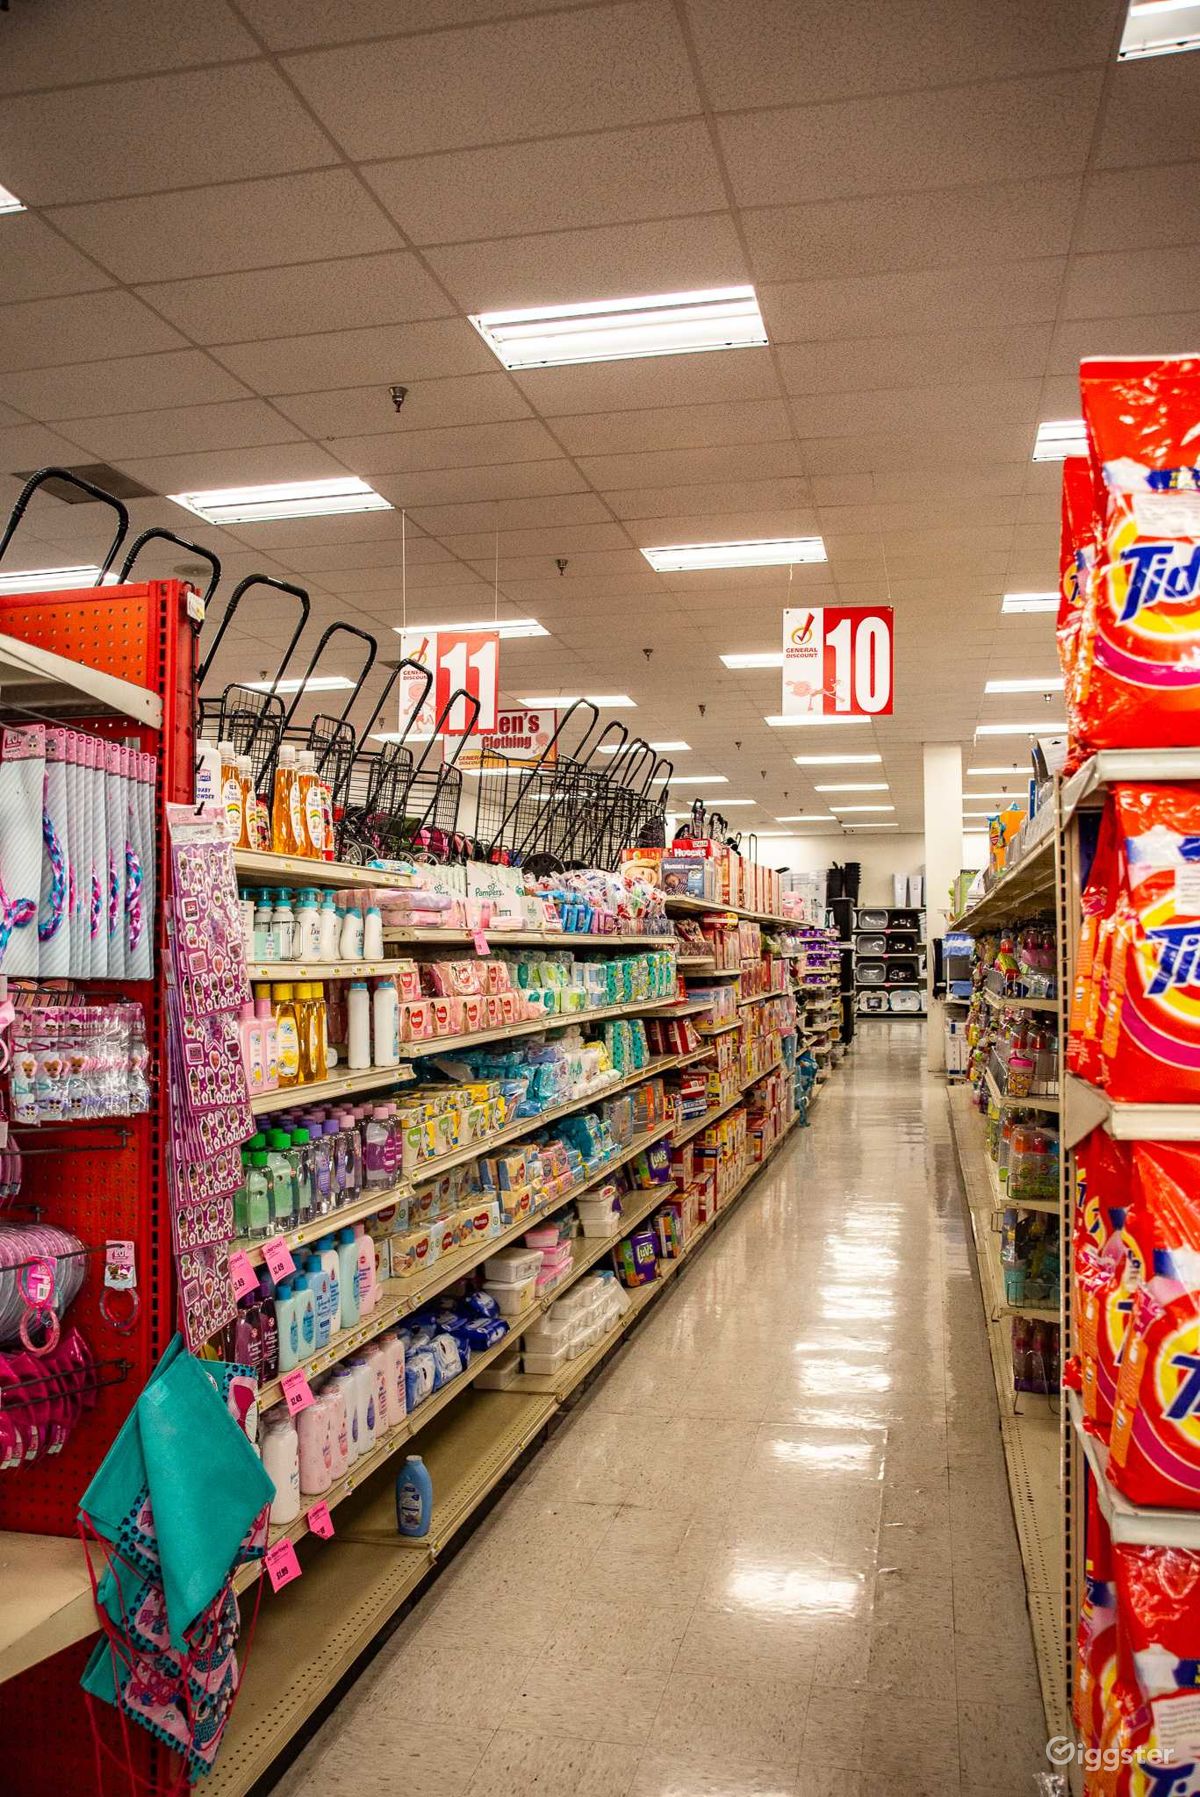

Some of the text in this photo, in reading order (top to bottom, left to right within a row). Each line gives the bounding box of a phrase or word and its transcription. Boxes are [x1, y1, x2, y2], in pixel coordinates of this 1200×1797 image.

[440, 641, 496, 730] 11
[825, 616, 890, 713] 10
[481, 736, 532, 749] Clothing
[475, 887, 502, 897] Pampers
